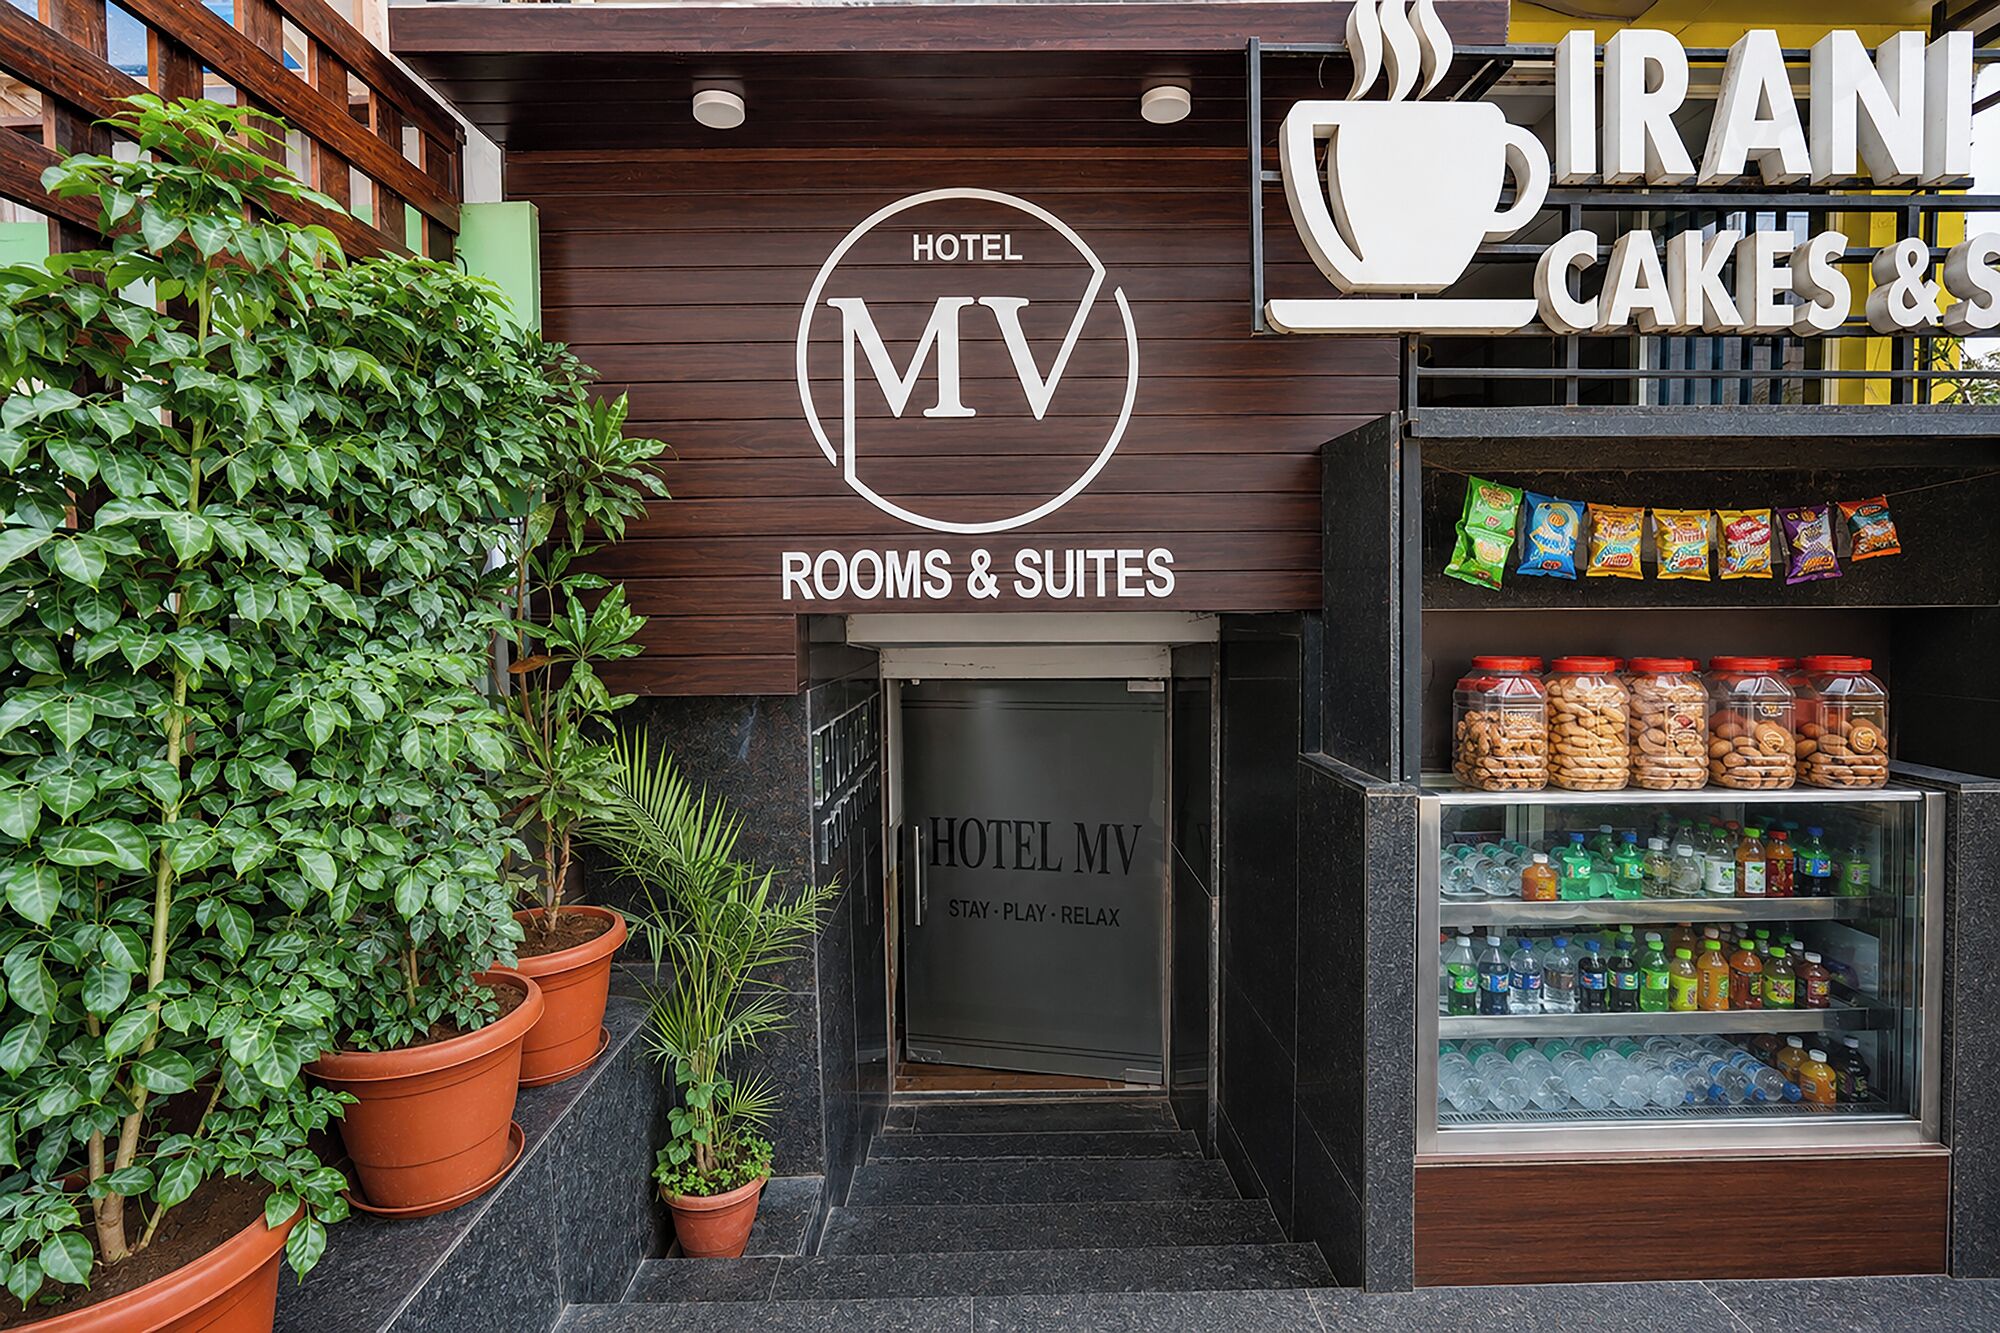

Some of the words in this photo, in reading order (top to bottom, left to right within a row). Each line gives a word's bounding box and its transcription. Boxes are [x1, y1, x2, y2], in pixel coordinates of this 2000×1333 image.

[1555, 28, 1974, 186] IRANI
[912, 233, 1023, 262] HOTEL
[1533, 229, 1852, 337] CAKES
[1867, 236, 1942, 334] &
[826, 290, 1094, 424] MV
[781, 549, 952, 600] ROOMS
[966, 549, 1000, 599] &
[1013, 548, 1175, 598] SUITES
[929, 816, 1063, 872] HOTEL
[1073, 822, 1142, 875] MV
[949, 899, 990, 919] STAY
[1003, 903, 1047, 922] PLAY
[1061, 905, 1120, 927] RELAX
